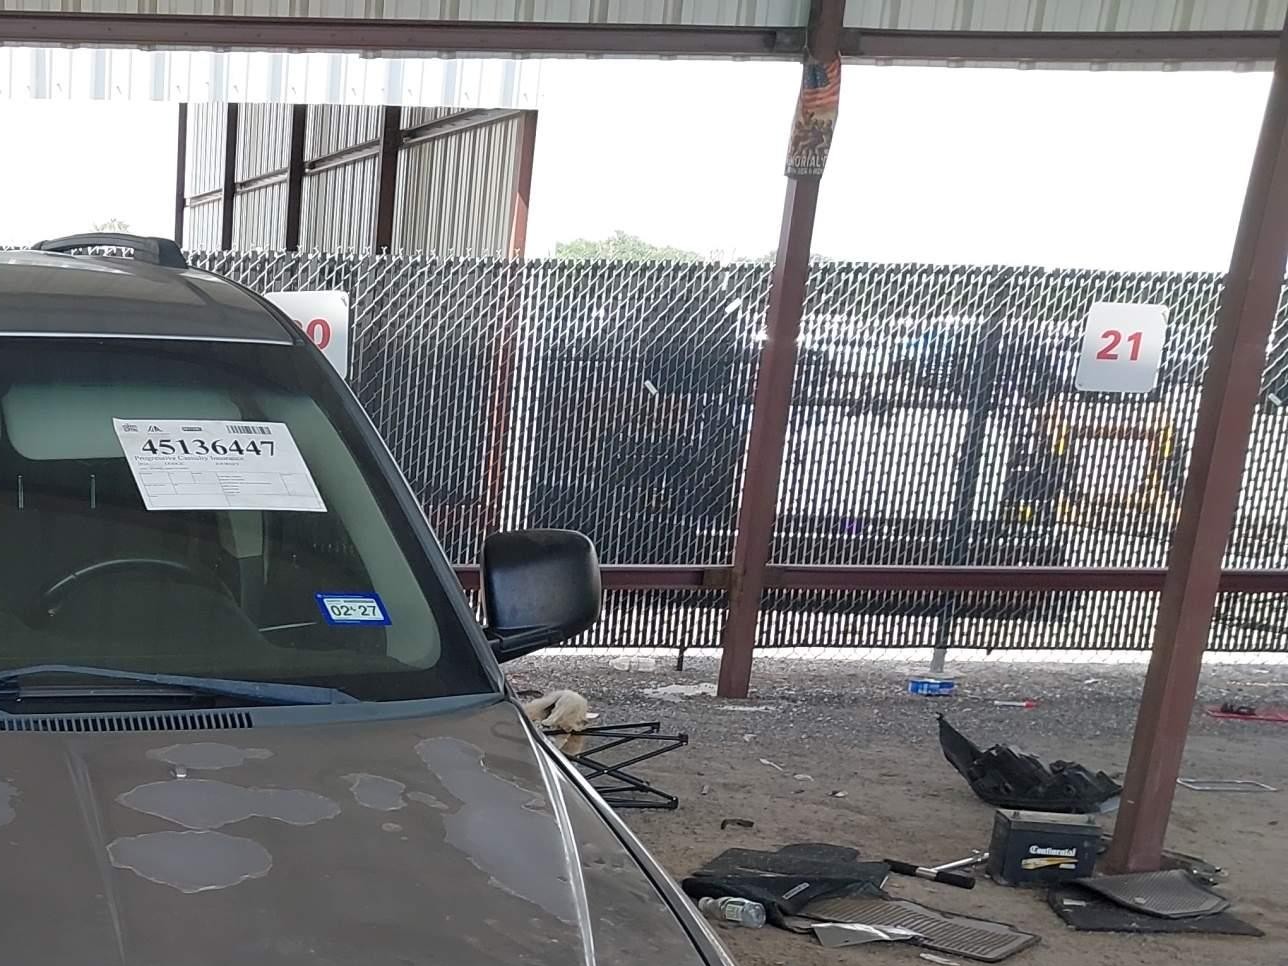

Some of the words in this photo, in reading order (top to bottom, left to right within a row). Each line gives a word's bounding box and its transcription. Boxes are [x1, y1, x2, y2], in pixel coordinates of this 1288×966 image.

[295, 318, 331, 350] 0
[1096, 329, 1143, 361] 21
[142, 439, 275, 457] 45136447
